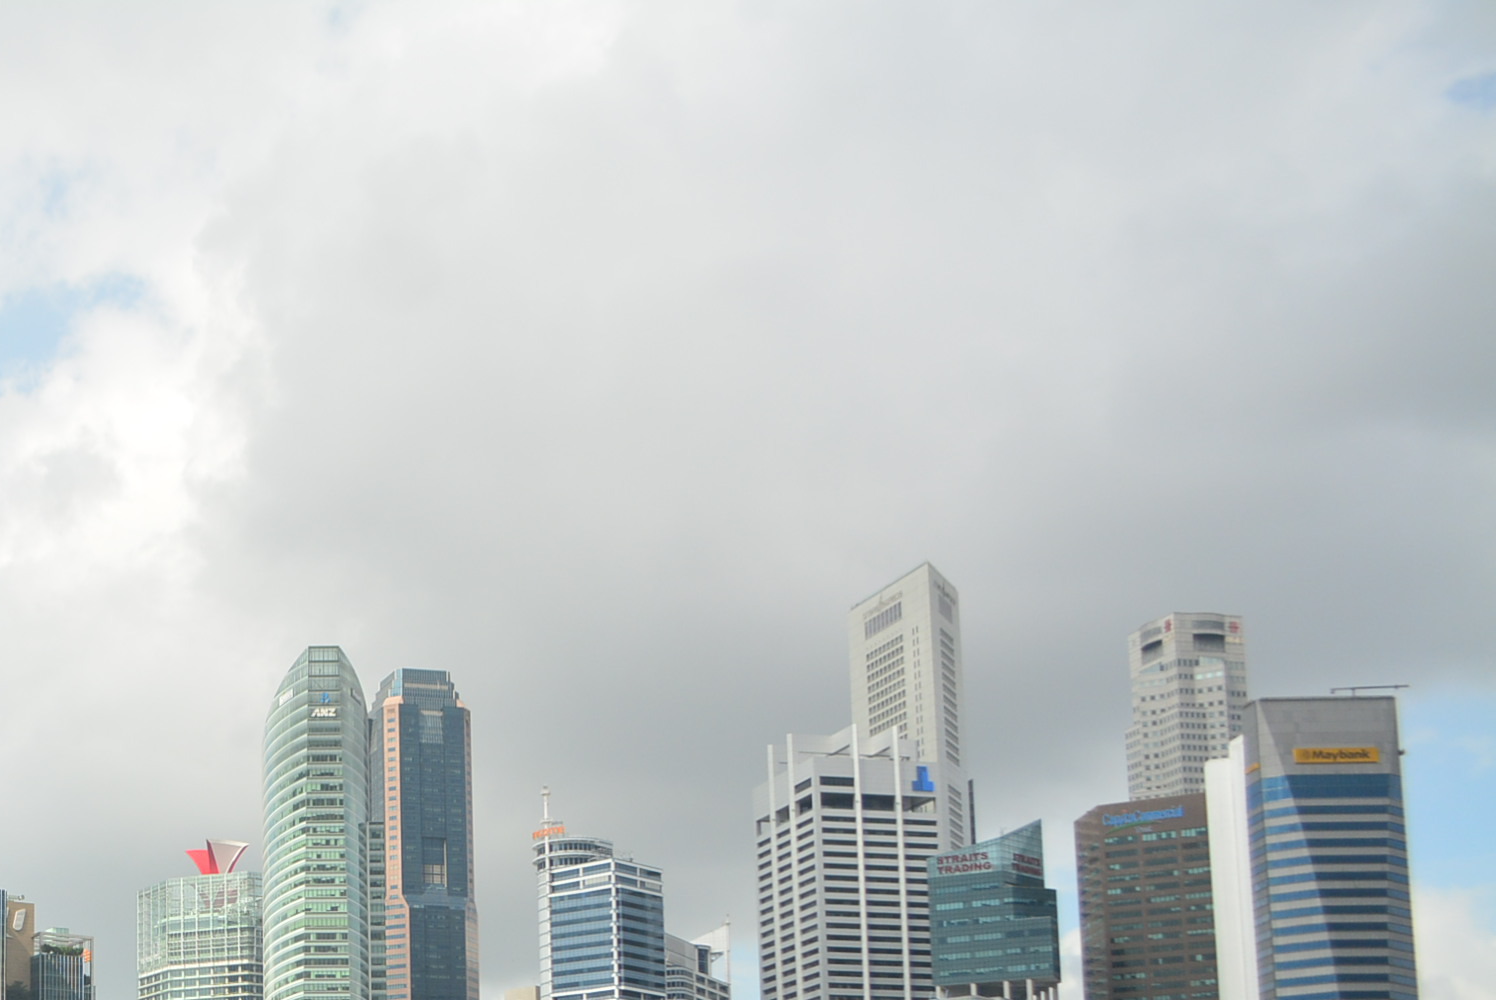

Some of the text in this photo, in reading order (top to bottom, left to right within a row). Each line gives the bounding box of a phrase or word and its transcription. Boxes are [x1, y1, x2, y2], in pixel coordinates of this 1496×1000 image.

[311, 706, 337, 718] ANZ
[1312, 749, 1371, 762] Maybank
[937, 852, 989, 865] STRAITS
[937, 861, 992, 875] TRADING
